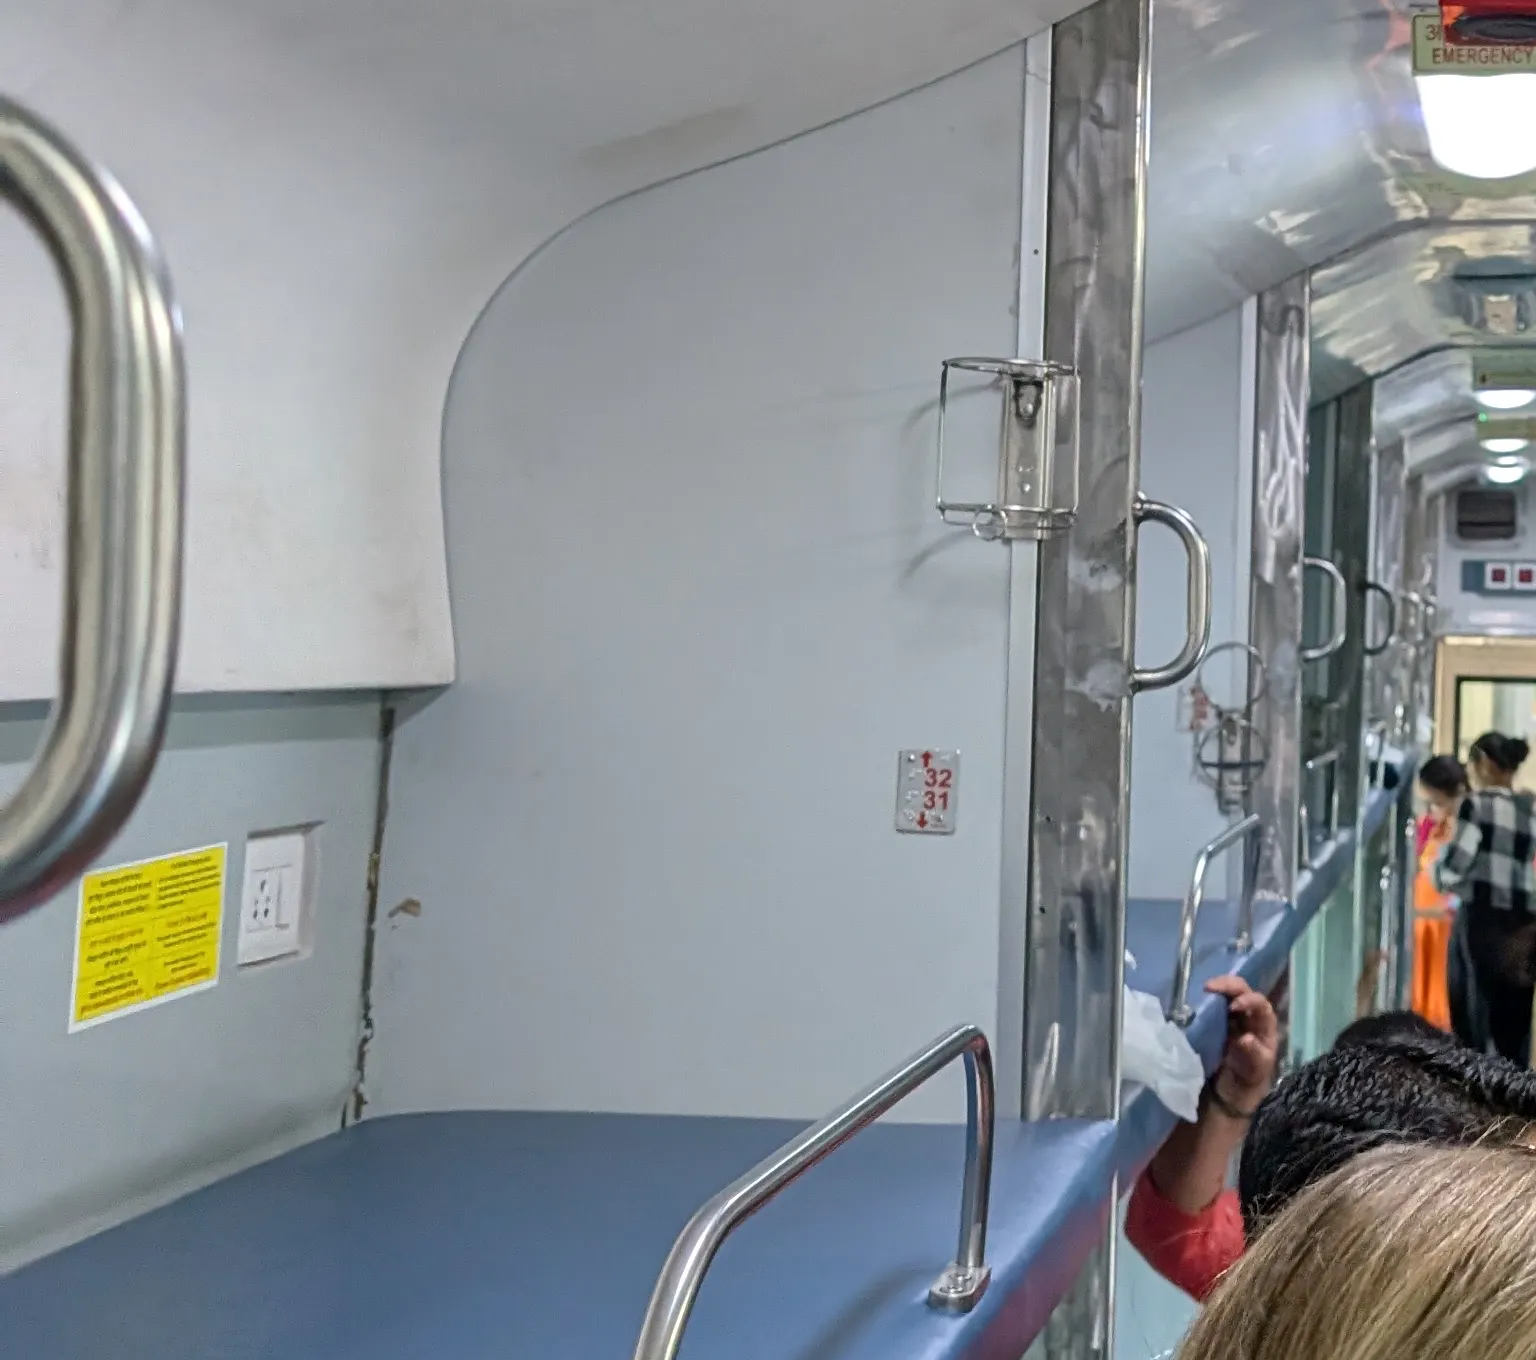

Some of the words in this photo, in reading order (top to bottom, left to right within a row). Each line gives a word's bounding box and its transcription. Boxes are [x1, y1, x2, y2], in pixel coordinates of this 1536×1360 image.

[1432, 47, 1533, 65] EMERGENCY
[924, 767, 953, 789] 32
[923, 790, 949, 811] 31
